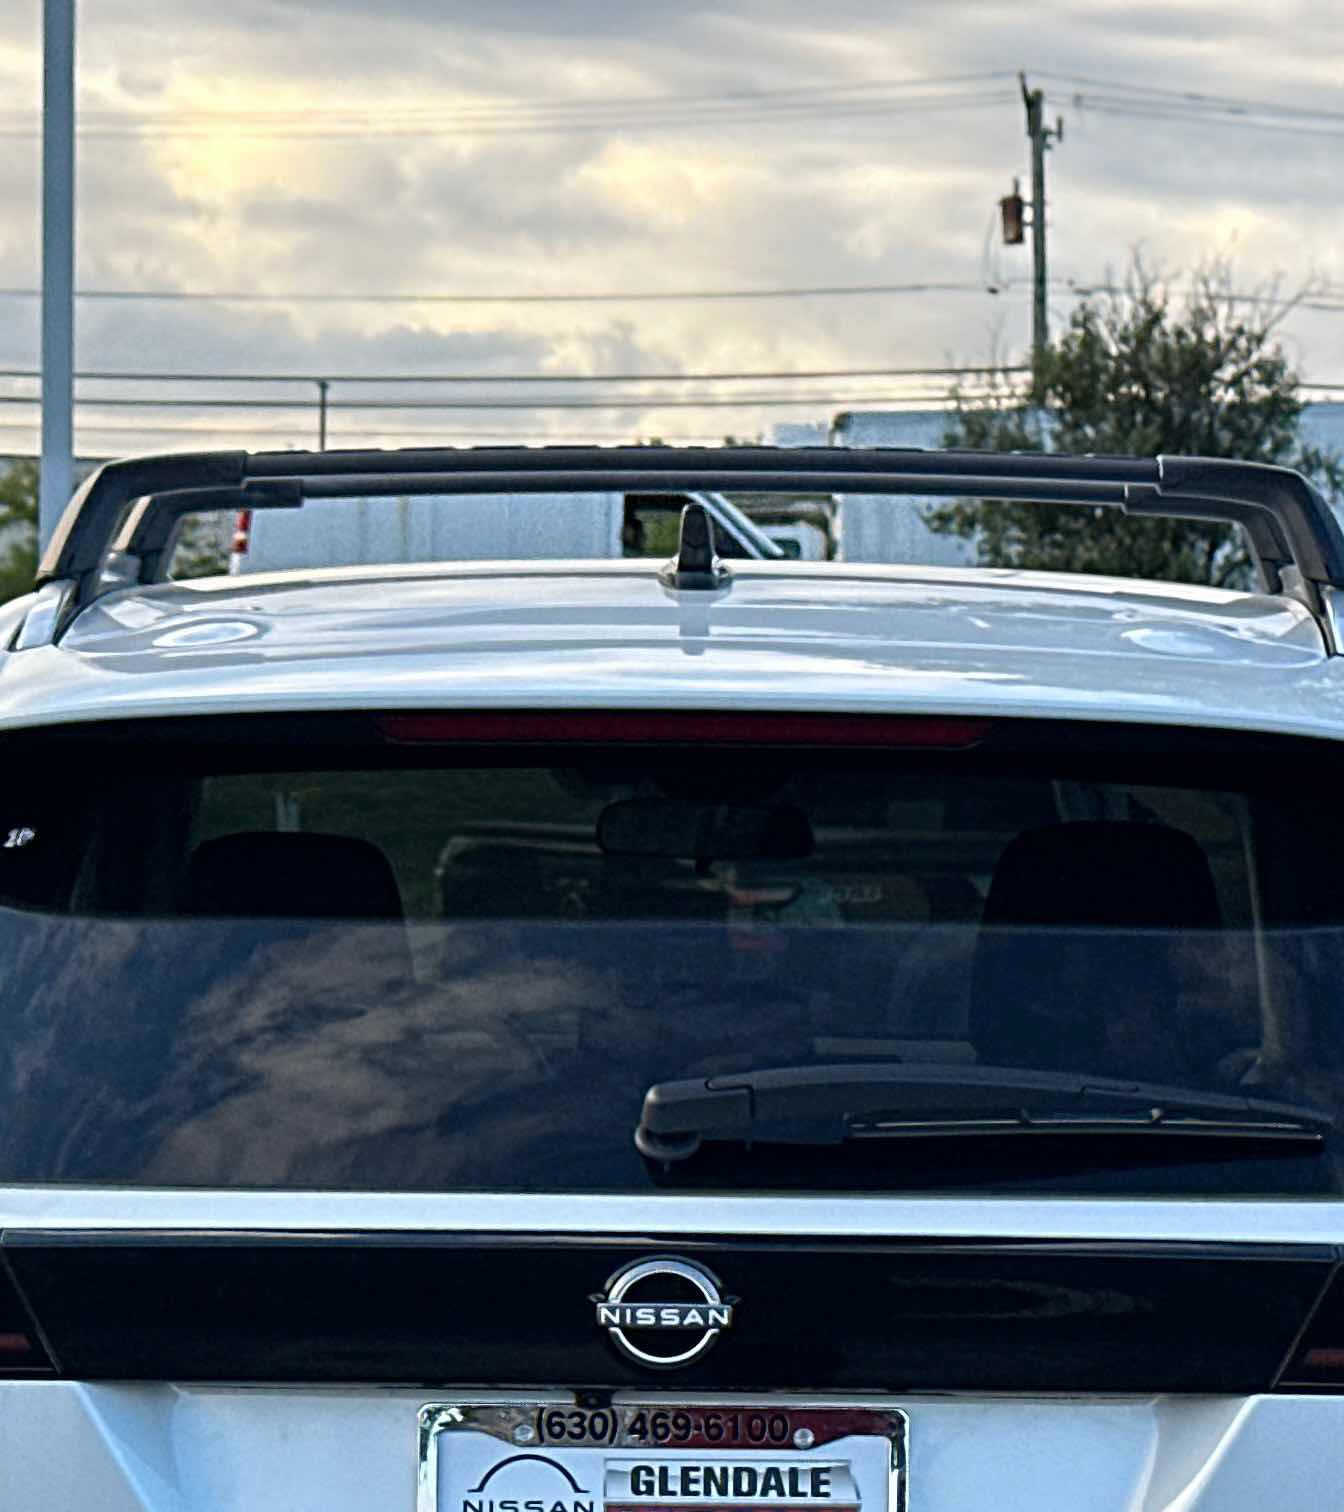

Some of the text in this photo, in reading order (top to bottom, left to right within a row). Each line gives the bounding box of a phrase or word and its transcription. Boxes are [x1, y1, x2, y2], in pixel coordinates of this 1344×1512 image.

[600, 1308, 729, 1325] NISSAN
[535, 1406, 790, 1445] (630) 469-6100
[630, 1465, 832, 1498] GLENDALE
